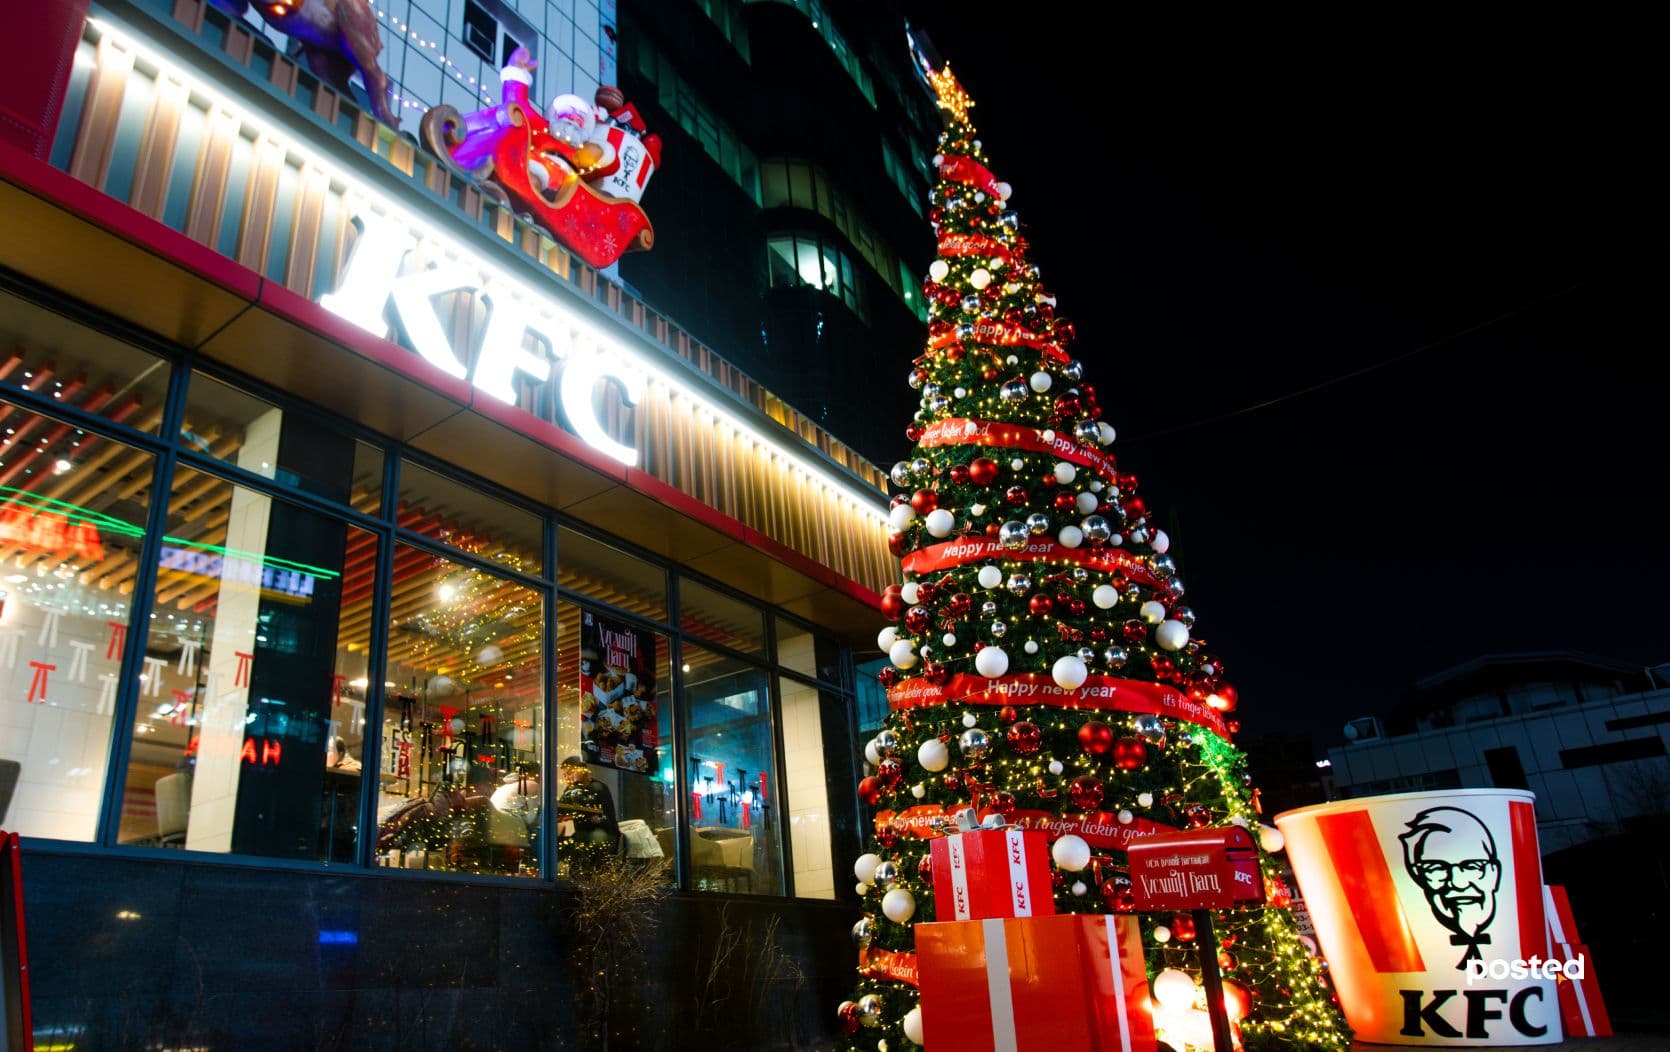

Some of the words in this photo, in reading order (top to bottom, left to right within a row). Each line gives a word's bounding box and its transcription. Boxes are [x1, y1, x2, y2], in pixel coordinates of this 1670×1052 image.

[613, 176, 630, 192] KFC
[320, 203, 638, 467] KFC
[942, 543, 984, 559] Happy
[987, 542, 1008, 552] ne
[987, 679, 1038, 697] Happy
[1042, 685, 1076, 696] new
[1080, 686, 1117, 699] year
[1163, 693, 1176, 707] it's
[1034, 817, 1078, 836] finger
[1081, 816, 1121, 838] lickin'
[1012, 838, 1021, 865] KFC
[1234, 870, 1252, 885] KFC
[956, 887, 965, 913] KFC
[1016, 882, 1026, 909] KFC
[1399, 986, 1548, 1039] KFC
